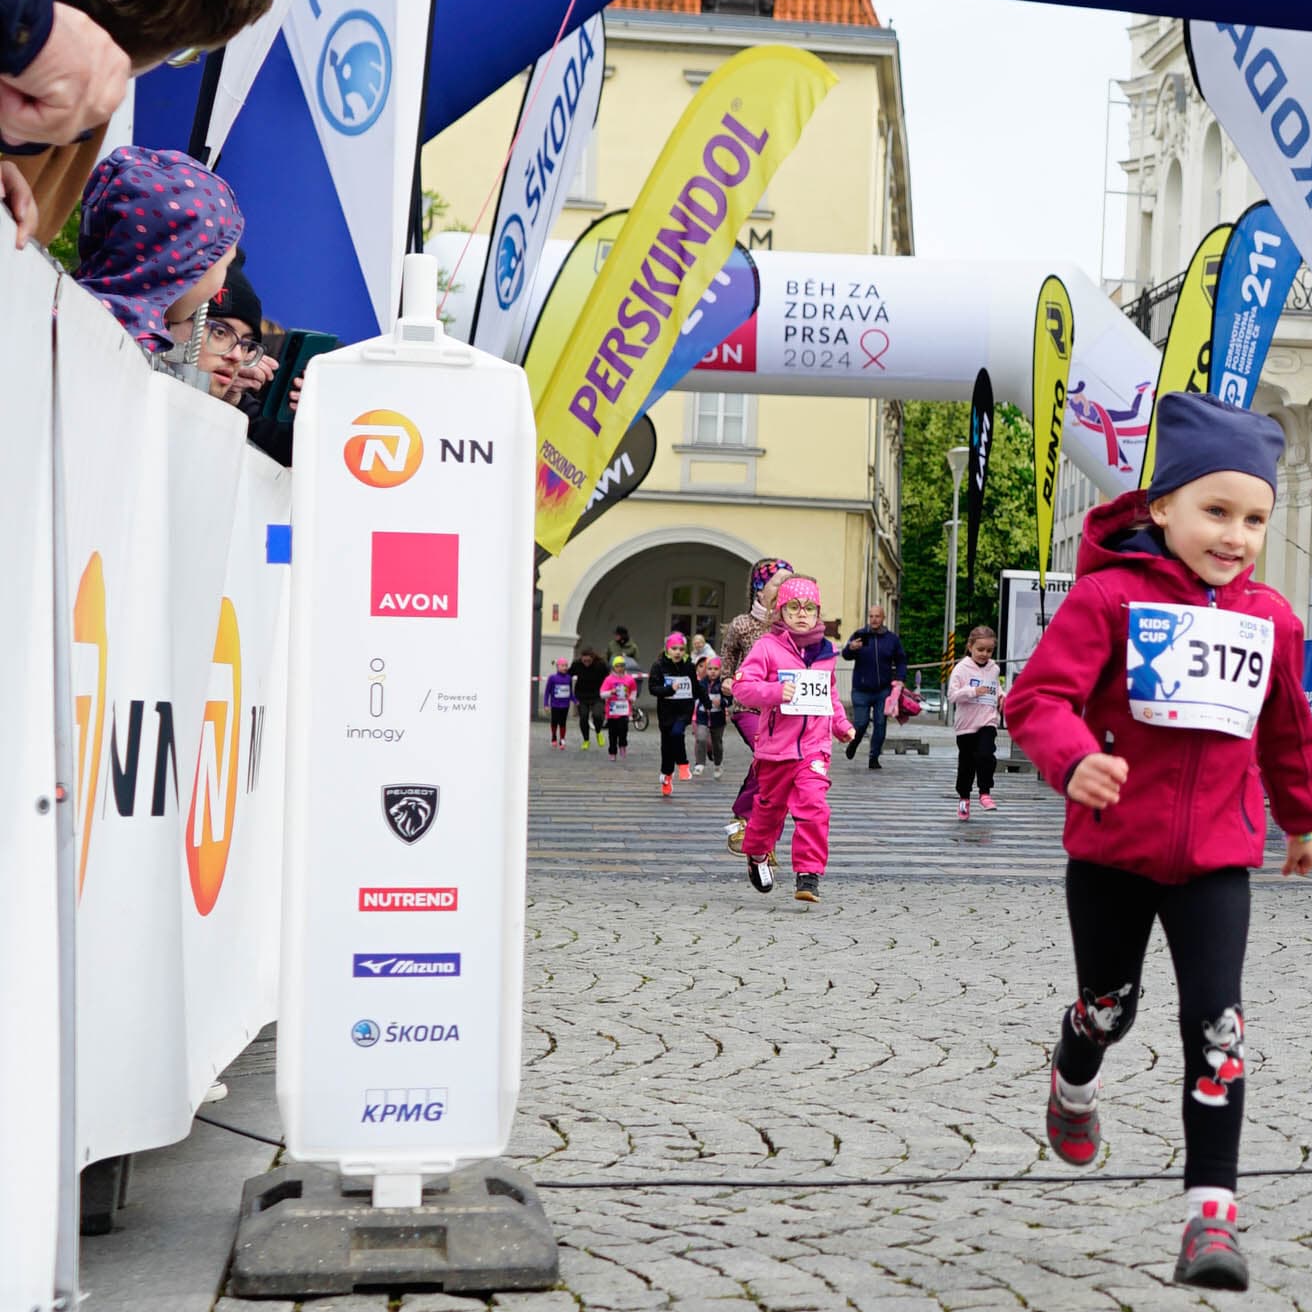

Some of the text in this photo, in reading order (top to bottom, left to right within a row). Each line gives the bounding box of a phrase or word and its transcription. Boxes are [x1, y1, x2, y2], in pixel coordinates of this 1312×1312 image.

[525, 24, 594, 227] ŠKODA
[568, 112, 769, 438] PERSKINDOL
[1241, 230, 1281, 308] 211
[786, 278, 880, 299] BĚH ZA
[784, 301, 889, 322] ZDRAVÁ
[784, 325, 849, 345] PRSA
[784, 348, 851, 369] 2024
[439, 438, 494, 464] NN
[1042, 379, 1066, 508] RUNTO
[378, 592, 449, 611] AVON
[1139, 618, 1170, 630] KIDS
[1139, 631, 1168, 643] CUP
[1187, 639, 1264, 689] 3179
[437, 692, 478, 701] Powered
[800, 682, 828, 697] 3154
[437, 703, 477, 712] by MVM
[346, 724, 406, 743] innogy
[363, 892, 455, 908] NUTREND
[384, 1021, 460, 1043] ŠKODA
[361, 1102, 444, 1124] KPMG
